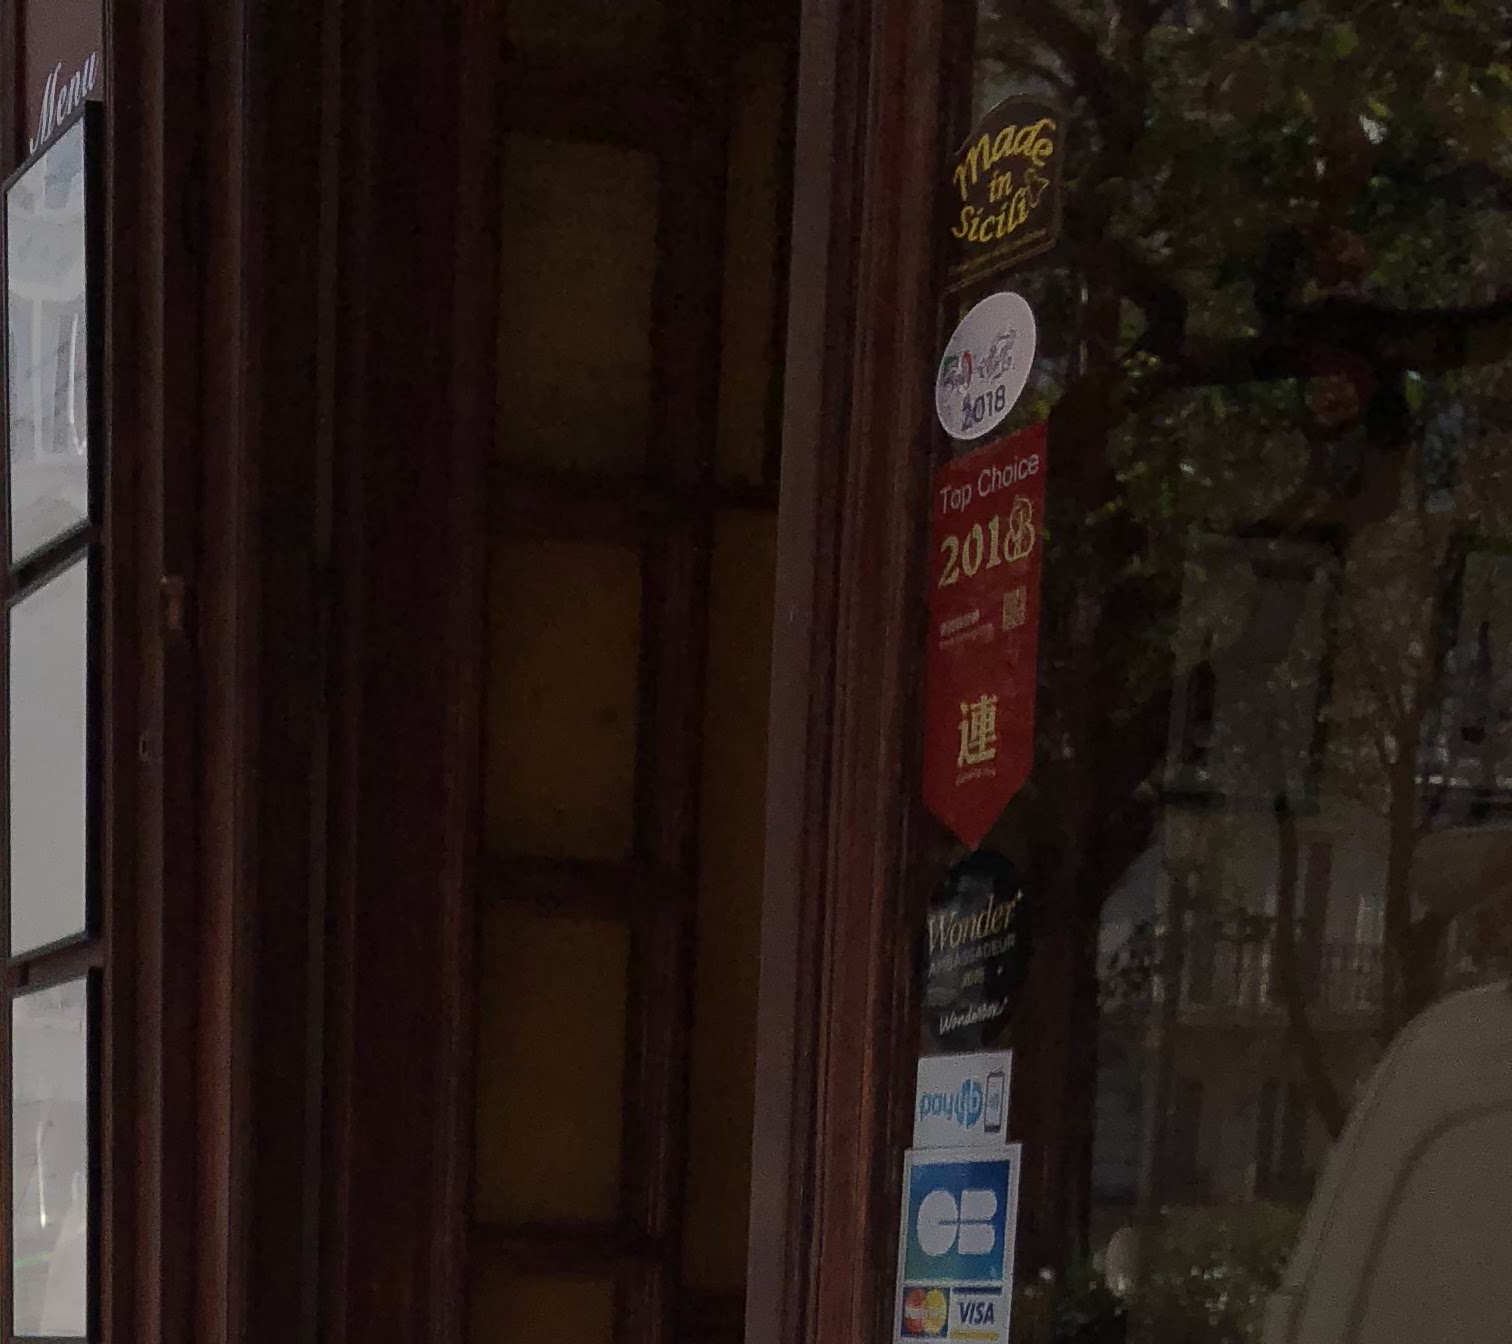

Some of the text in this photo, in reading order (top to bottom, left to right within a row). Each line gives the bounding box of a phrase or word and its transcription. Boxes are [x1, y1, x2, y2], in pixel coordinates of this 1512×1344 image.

[29, 51, 99, 156] Menu
[988, 169, 1013, 203] in
[961, 385, 1006, 432] 2018
[940, 453, 1040, 514] Top Choice
[937, 496, 1036, 590] 2018
[926, 893, 1017, 957] Wonder
[928, 932, 1017, 979] AMBASSADEUR
[916, 1187, 998, 1257] CB
[959, 1302, 995, 1325] VISA
